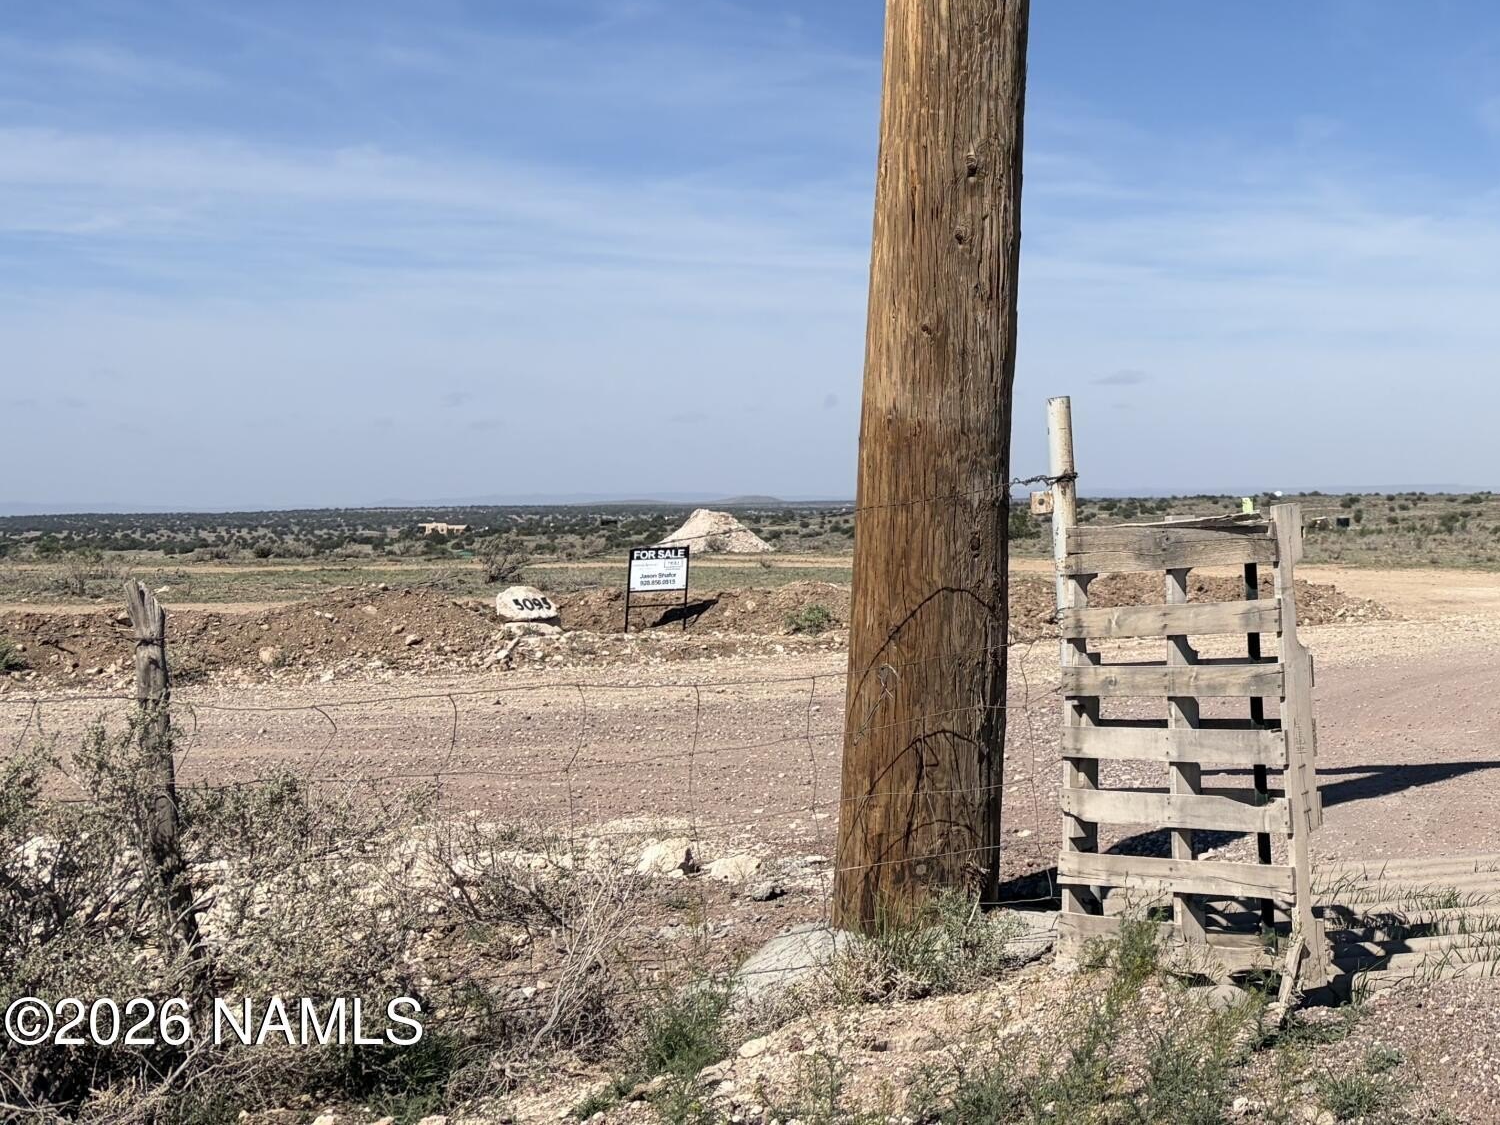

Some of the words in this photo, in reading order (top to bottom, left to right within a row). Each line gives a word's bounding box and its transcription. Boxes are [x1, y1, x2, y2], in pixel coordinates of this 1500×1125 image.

[633, 550, 656, 560] FOR
[657, 549, 685, 559] SALE
[512, 597, 551, 611] 5095
